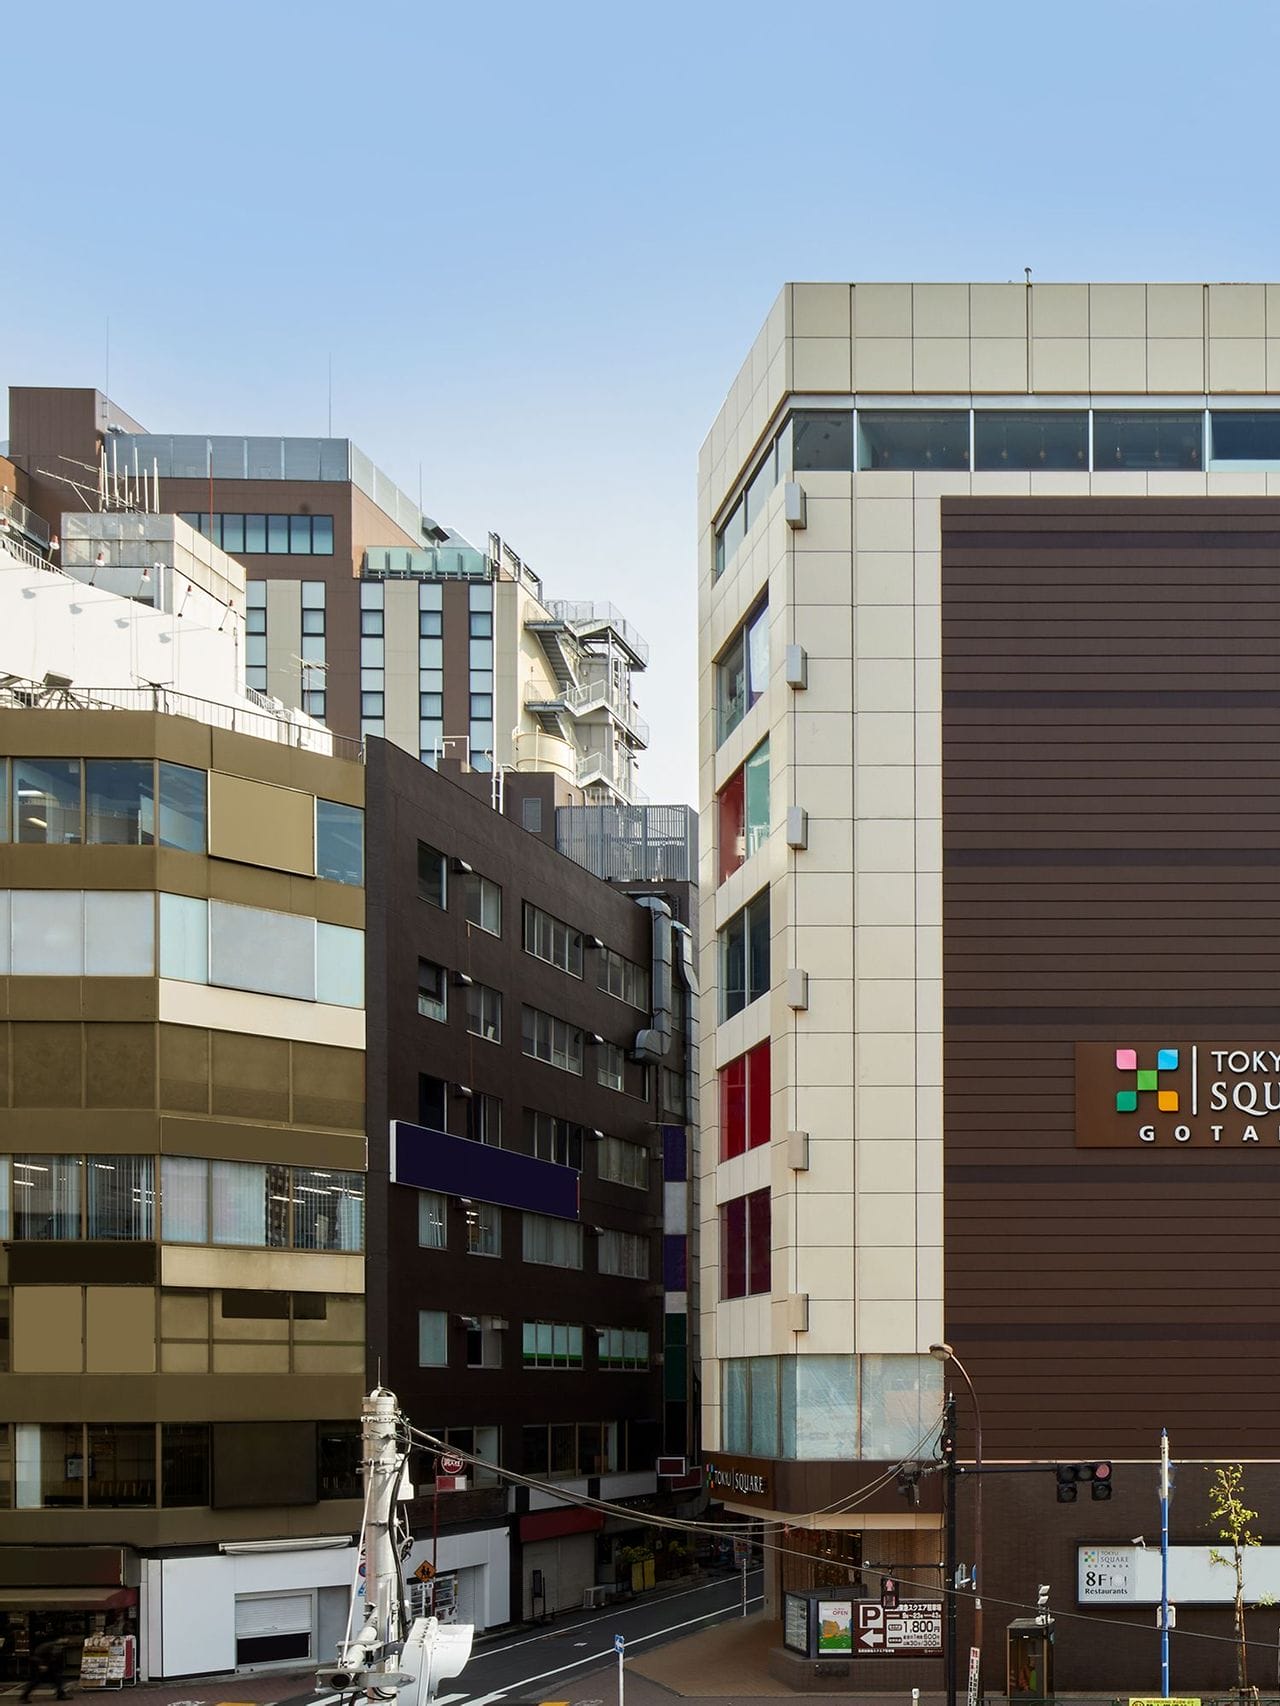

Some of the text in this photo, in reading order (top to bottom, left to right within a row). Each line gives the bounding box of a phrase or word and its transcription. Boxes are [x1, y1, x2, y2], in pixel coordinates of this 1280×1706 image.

[714, 1470, 765, 1494] TOKYU SQUARE
[1086, 1571, 1107, 1586] 8F
[862, 1606, 881, 1627] P
